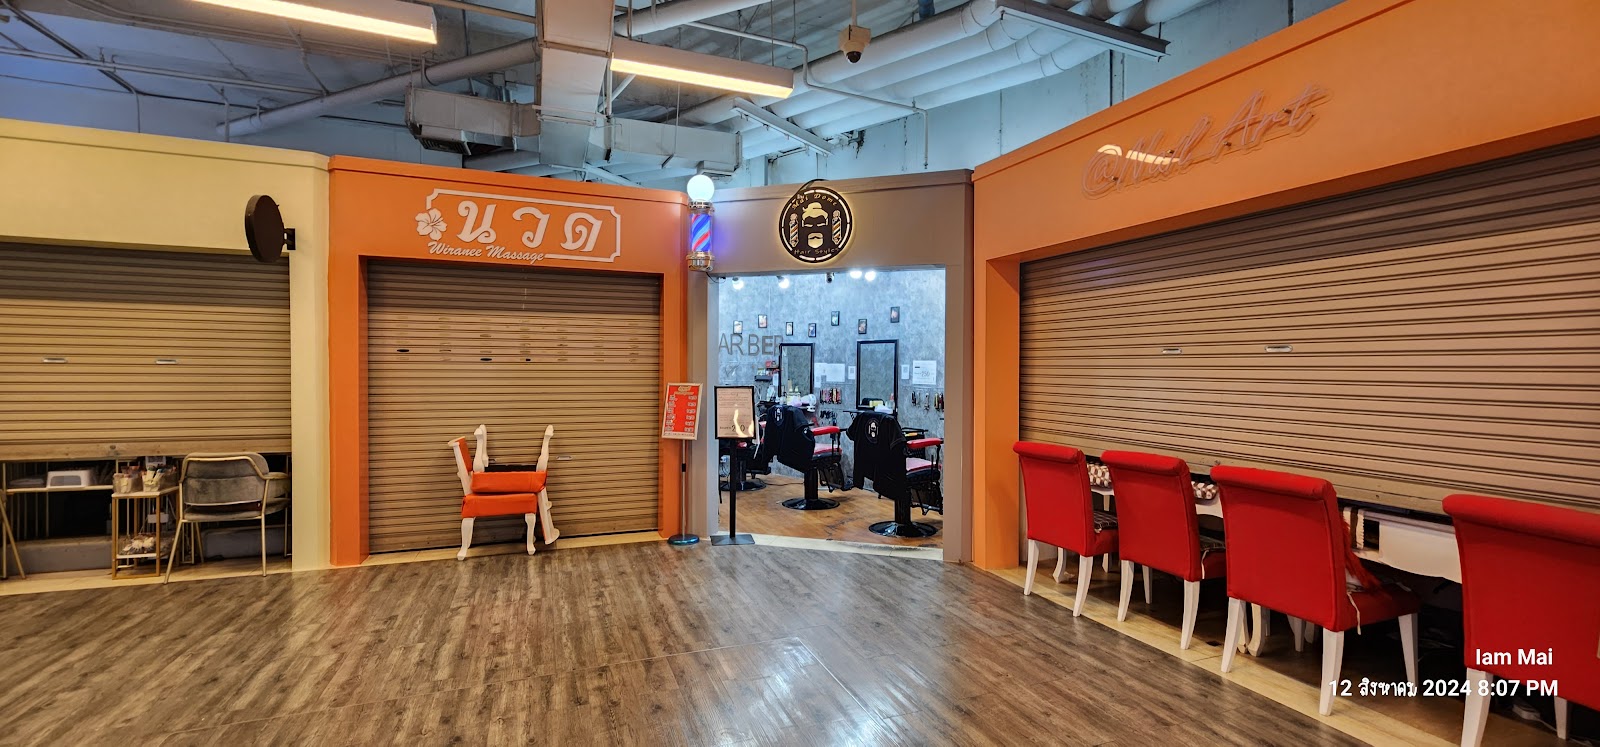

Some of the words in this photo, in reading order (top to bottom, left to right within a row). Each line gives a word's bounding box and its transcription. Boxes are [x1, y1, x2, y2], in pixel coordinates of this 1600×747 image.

[1209, 85, 1328, 156] Art
[456, 200, 603, 252] นวด
[427, 241, 482, 257] Wiranee
[485, 245, 544, 264] Massage
[731, 424, 745, 432] 20
